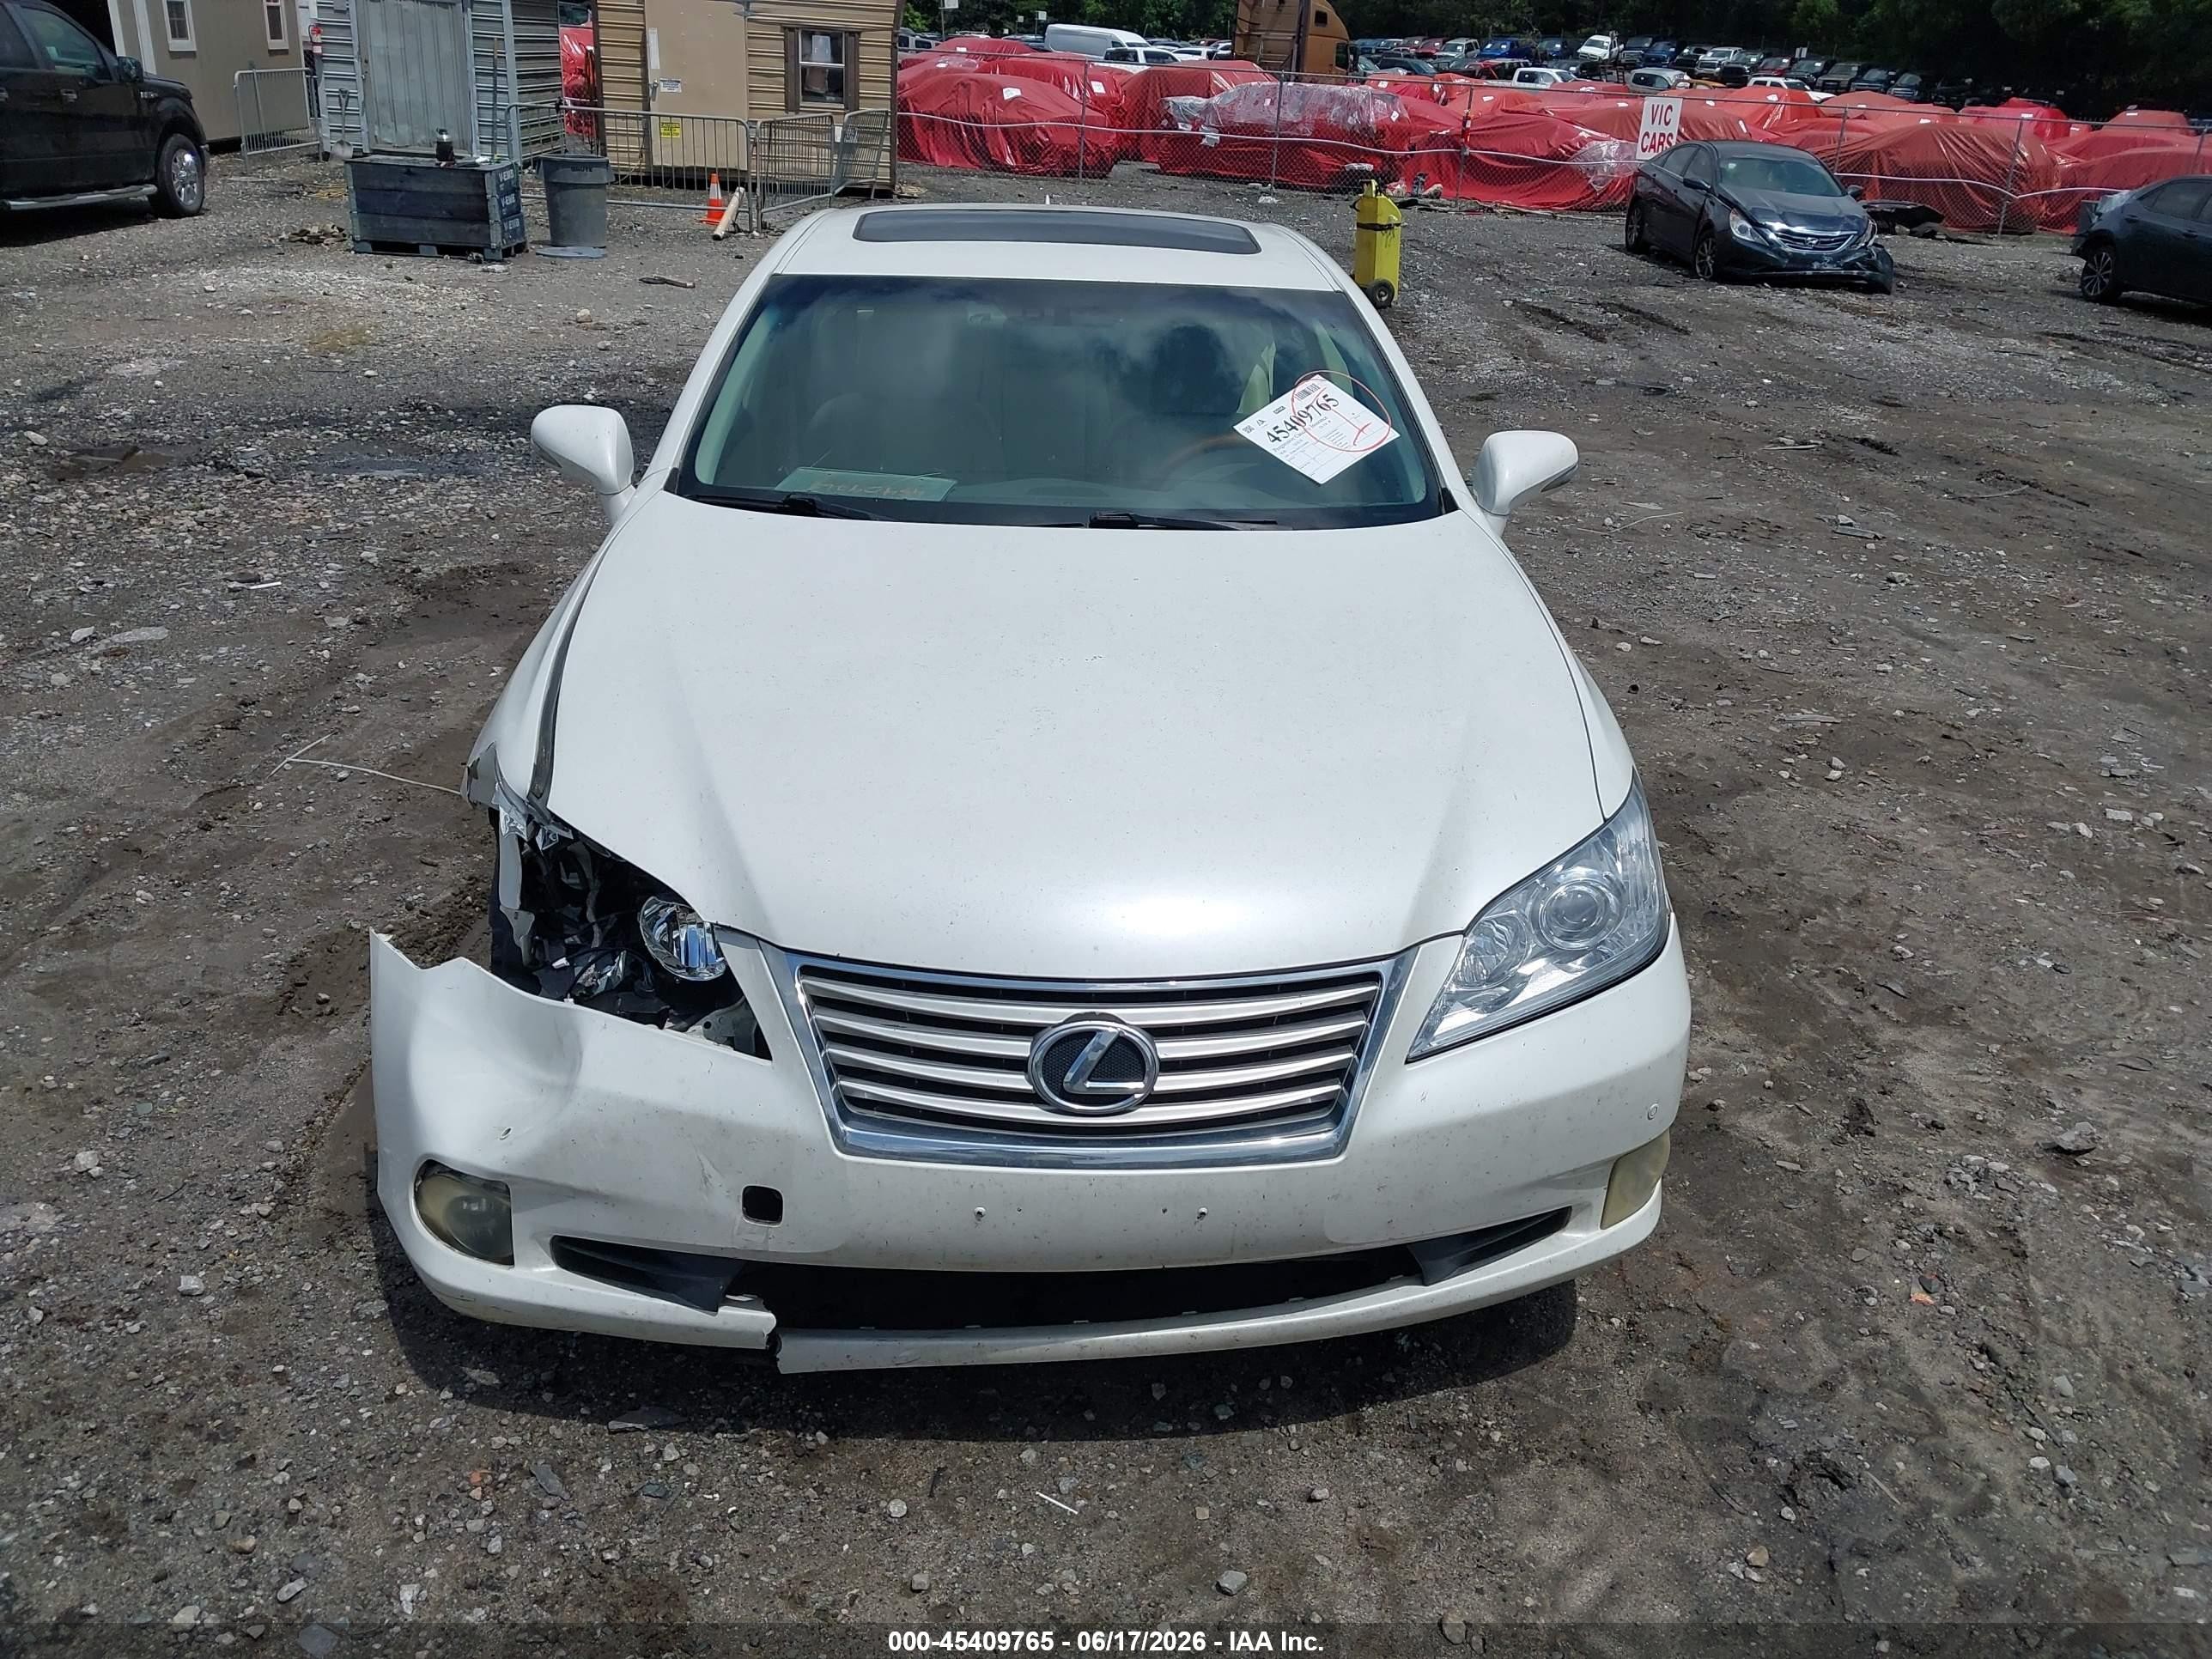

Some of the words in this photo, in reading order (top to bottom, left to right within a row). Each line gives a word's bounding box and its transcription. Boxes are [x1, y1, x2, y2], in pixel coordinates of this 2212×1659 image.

[1650, 103, 1674, 126] VIC
[1640, 131, 1674, 153] CARS
[1266, 393, 1340, 443] 45409765
